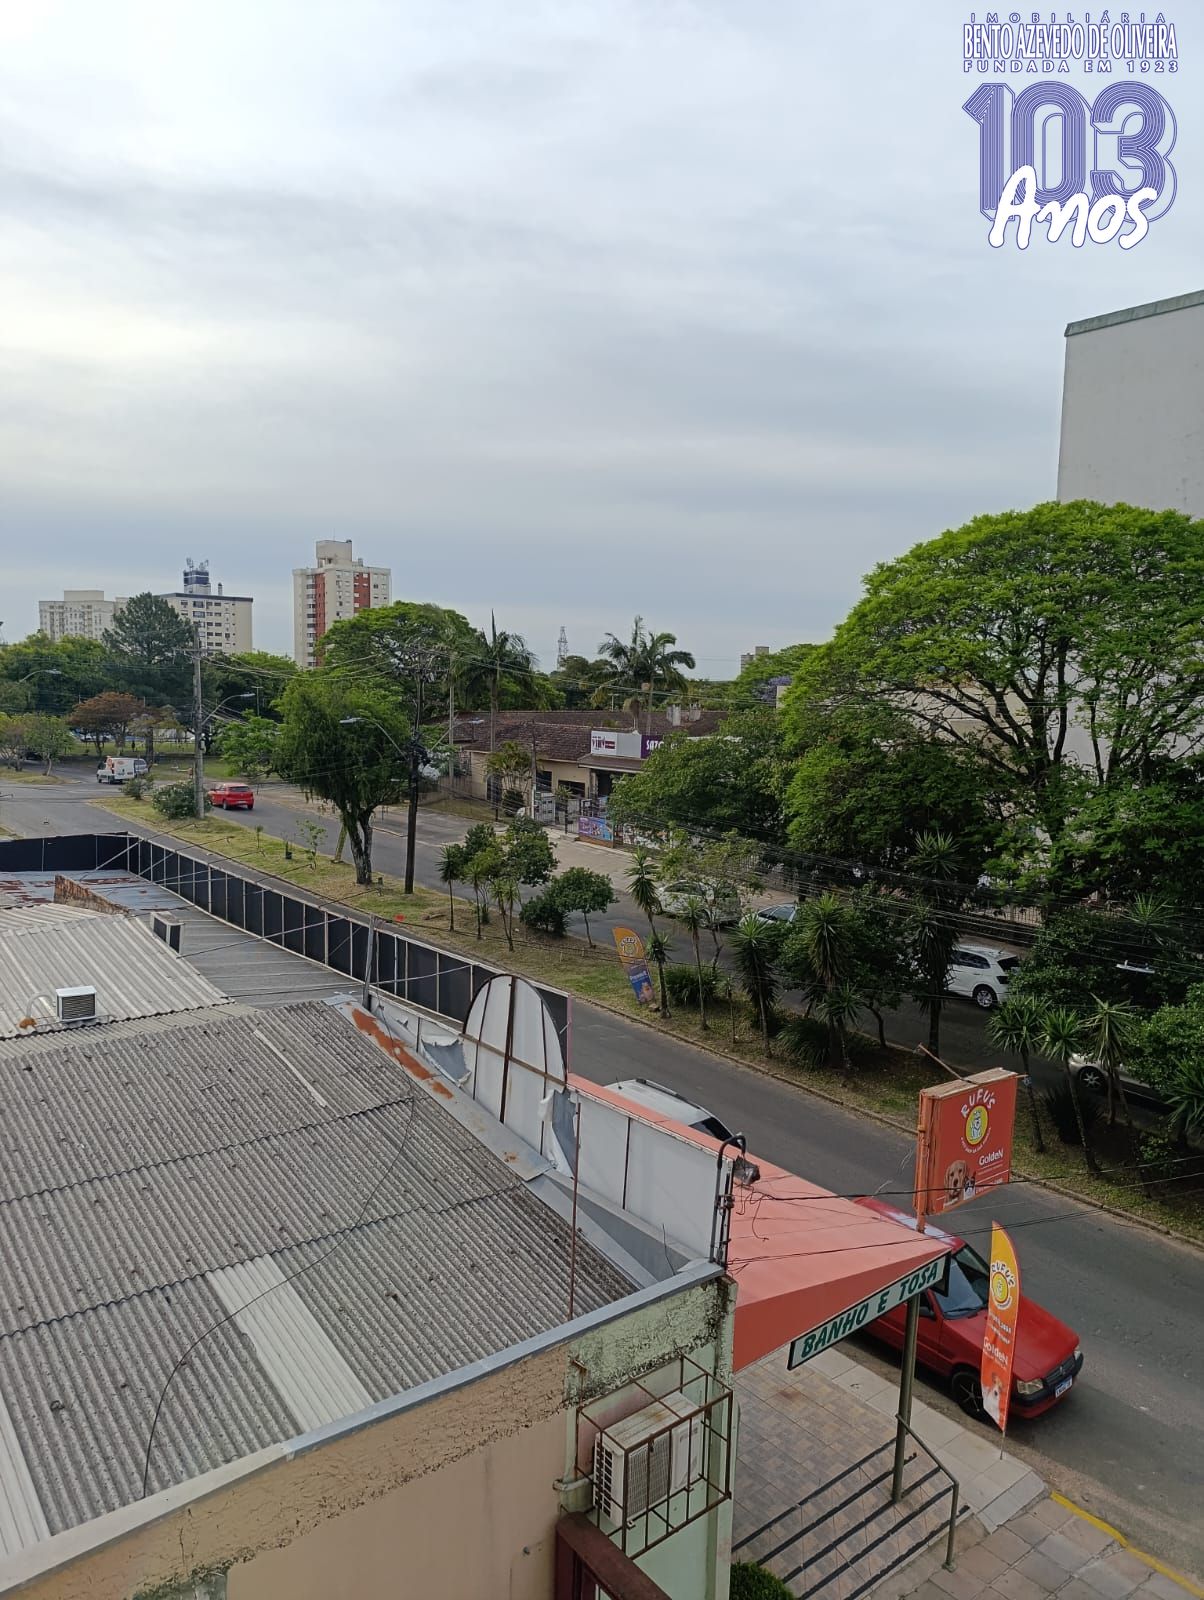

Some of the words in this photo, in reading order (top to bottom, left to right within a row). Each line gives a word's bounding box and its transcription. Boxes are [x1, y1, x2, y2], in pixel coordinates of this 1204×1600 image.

[961, 1088, 995, 1118] RUFU'S
[801, 1301, 868, 1358] BANHO
[877, 1290, 890, 1313] E
[899, 1262, 938, 1301] TOSA
